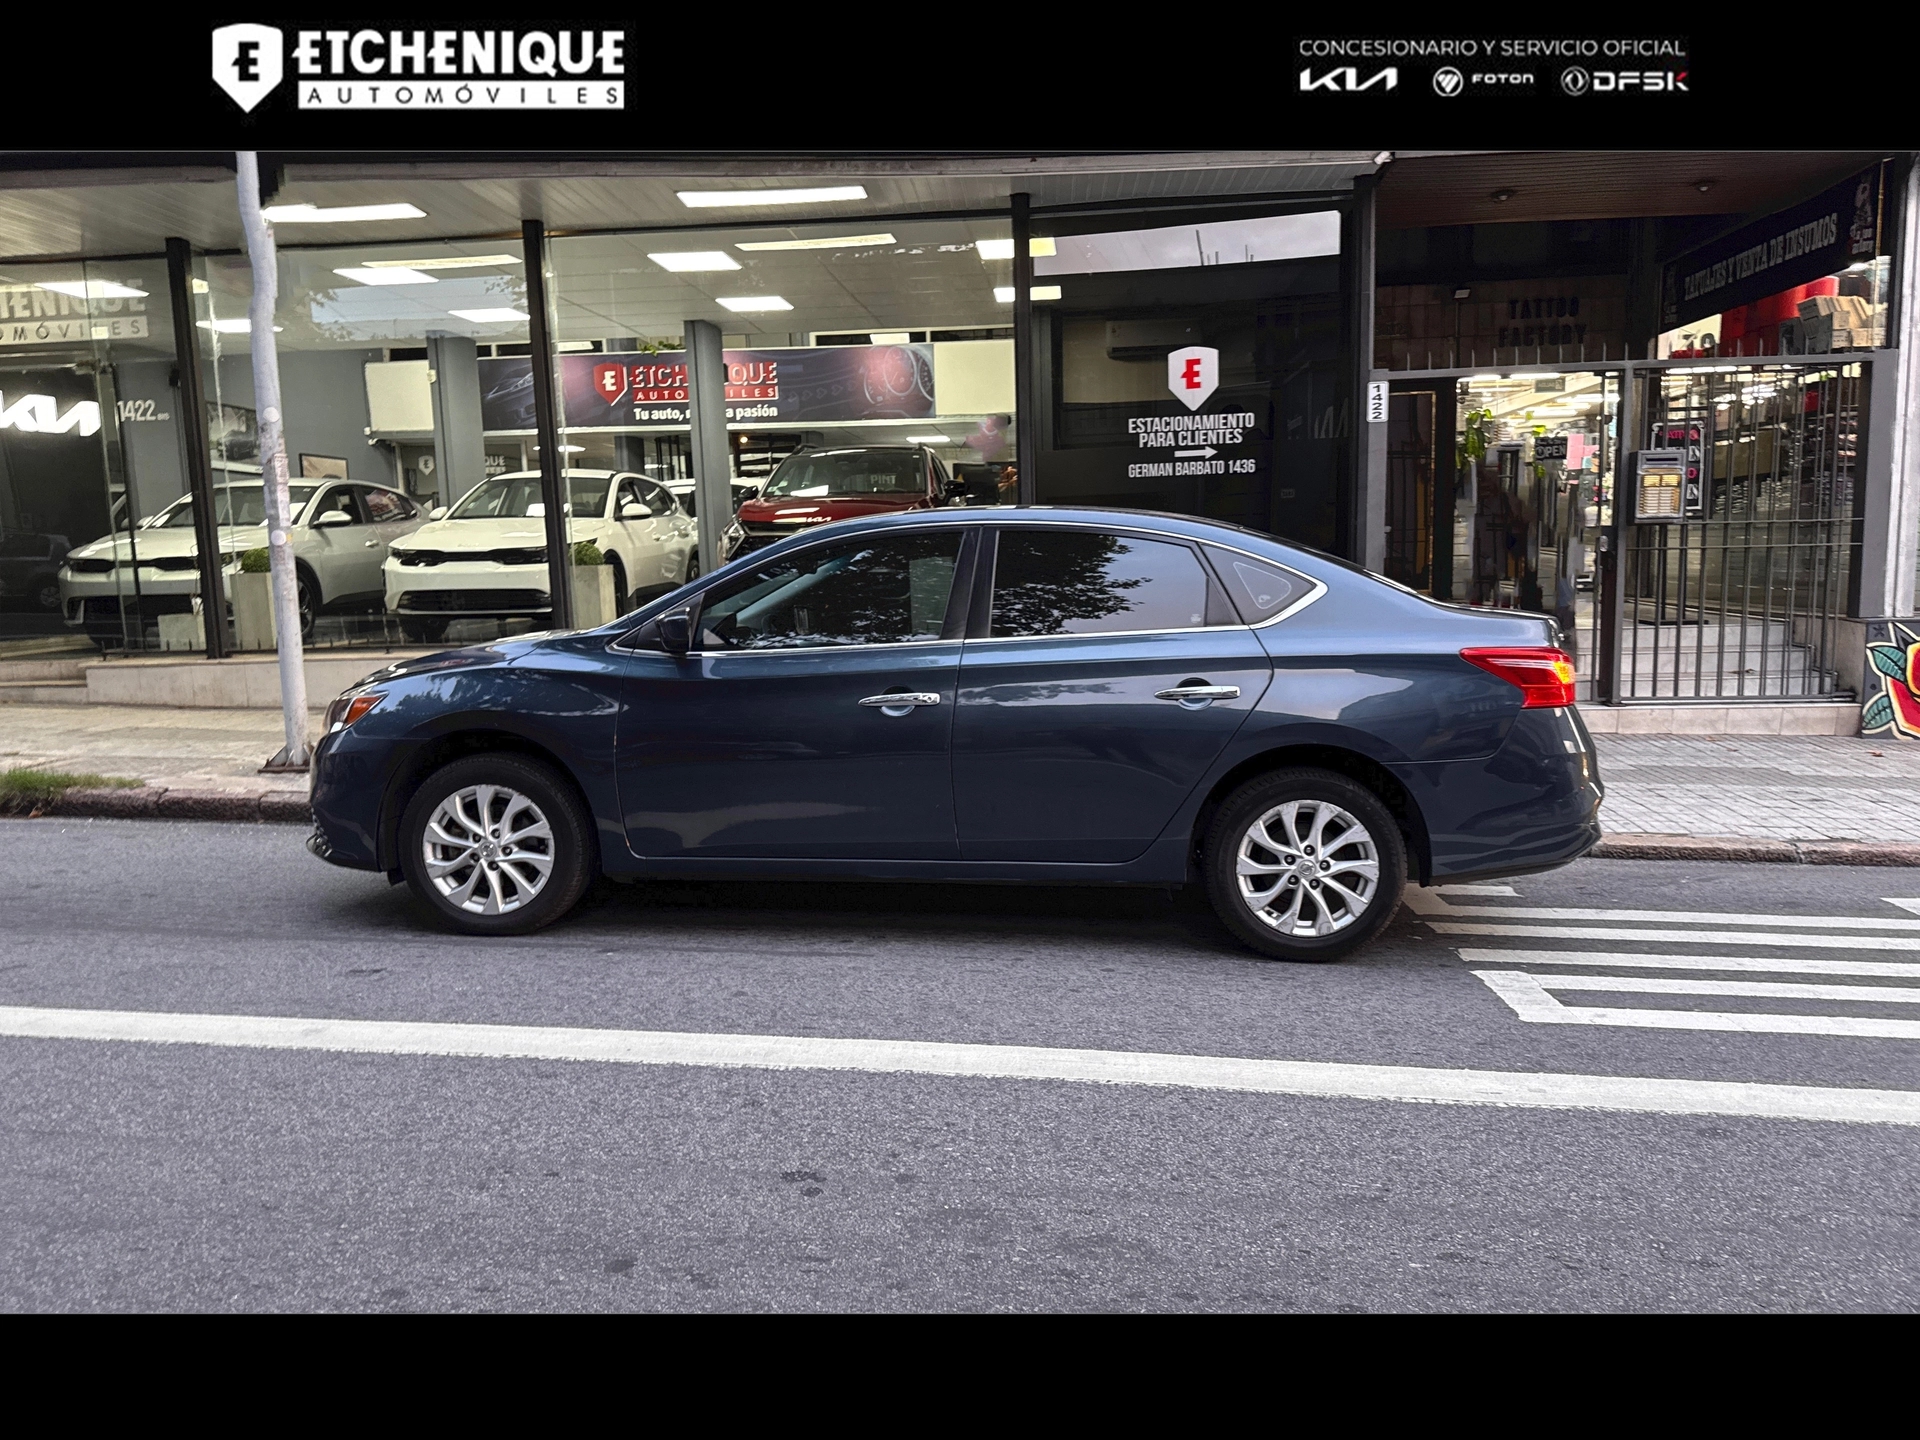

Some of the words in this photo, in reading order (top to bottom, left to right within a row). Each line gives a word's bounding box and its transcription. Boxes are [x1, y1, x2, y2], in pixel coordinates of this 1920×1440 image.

[1769, 234, 1785, 267] DE
[1785, 212, 1838, 261] INSUMOS
[1509, 296, 1580, 320] TATTOO
[1498, 323, 1587, 348] FACTORY
[117, 399, 156, 422] 1422
[633, 407, 650, 421] Tu
[651, 407, 685, 422] auto,
[735, 403, 778, 421] pasión
[1371, 384, 1384, 420] 1422
[1128, 412, 1256, 434] ESTACIONAMIENTO
[1139, 431, 1176, 448] PARA
[1178, 428, 1243, 446] CLIENTES
[1536, 445, 1567, 459] OPEN
[1128, 462, 1173, 478] GERMAN
[1175, 460, 1225, 476] BARBATO
[1228, 459, 1256, 474] 1436
